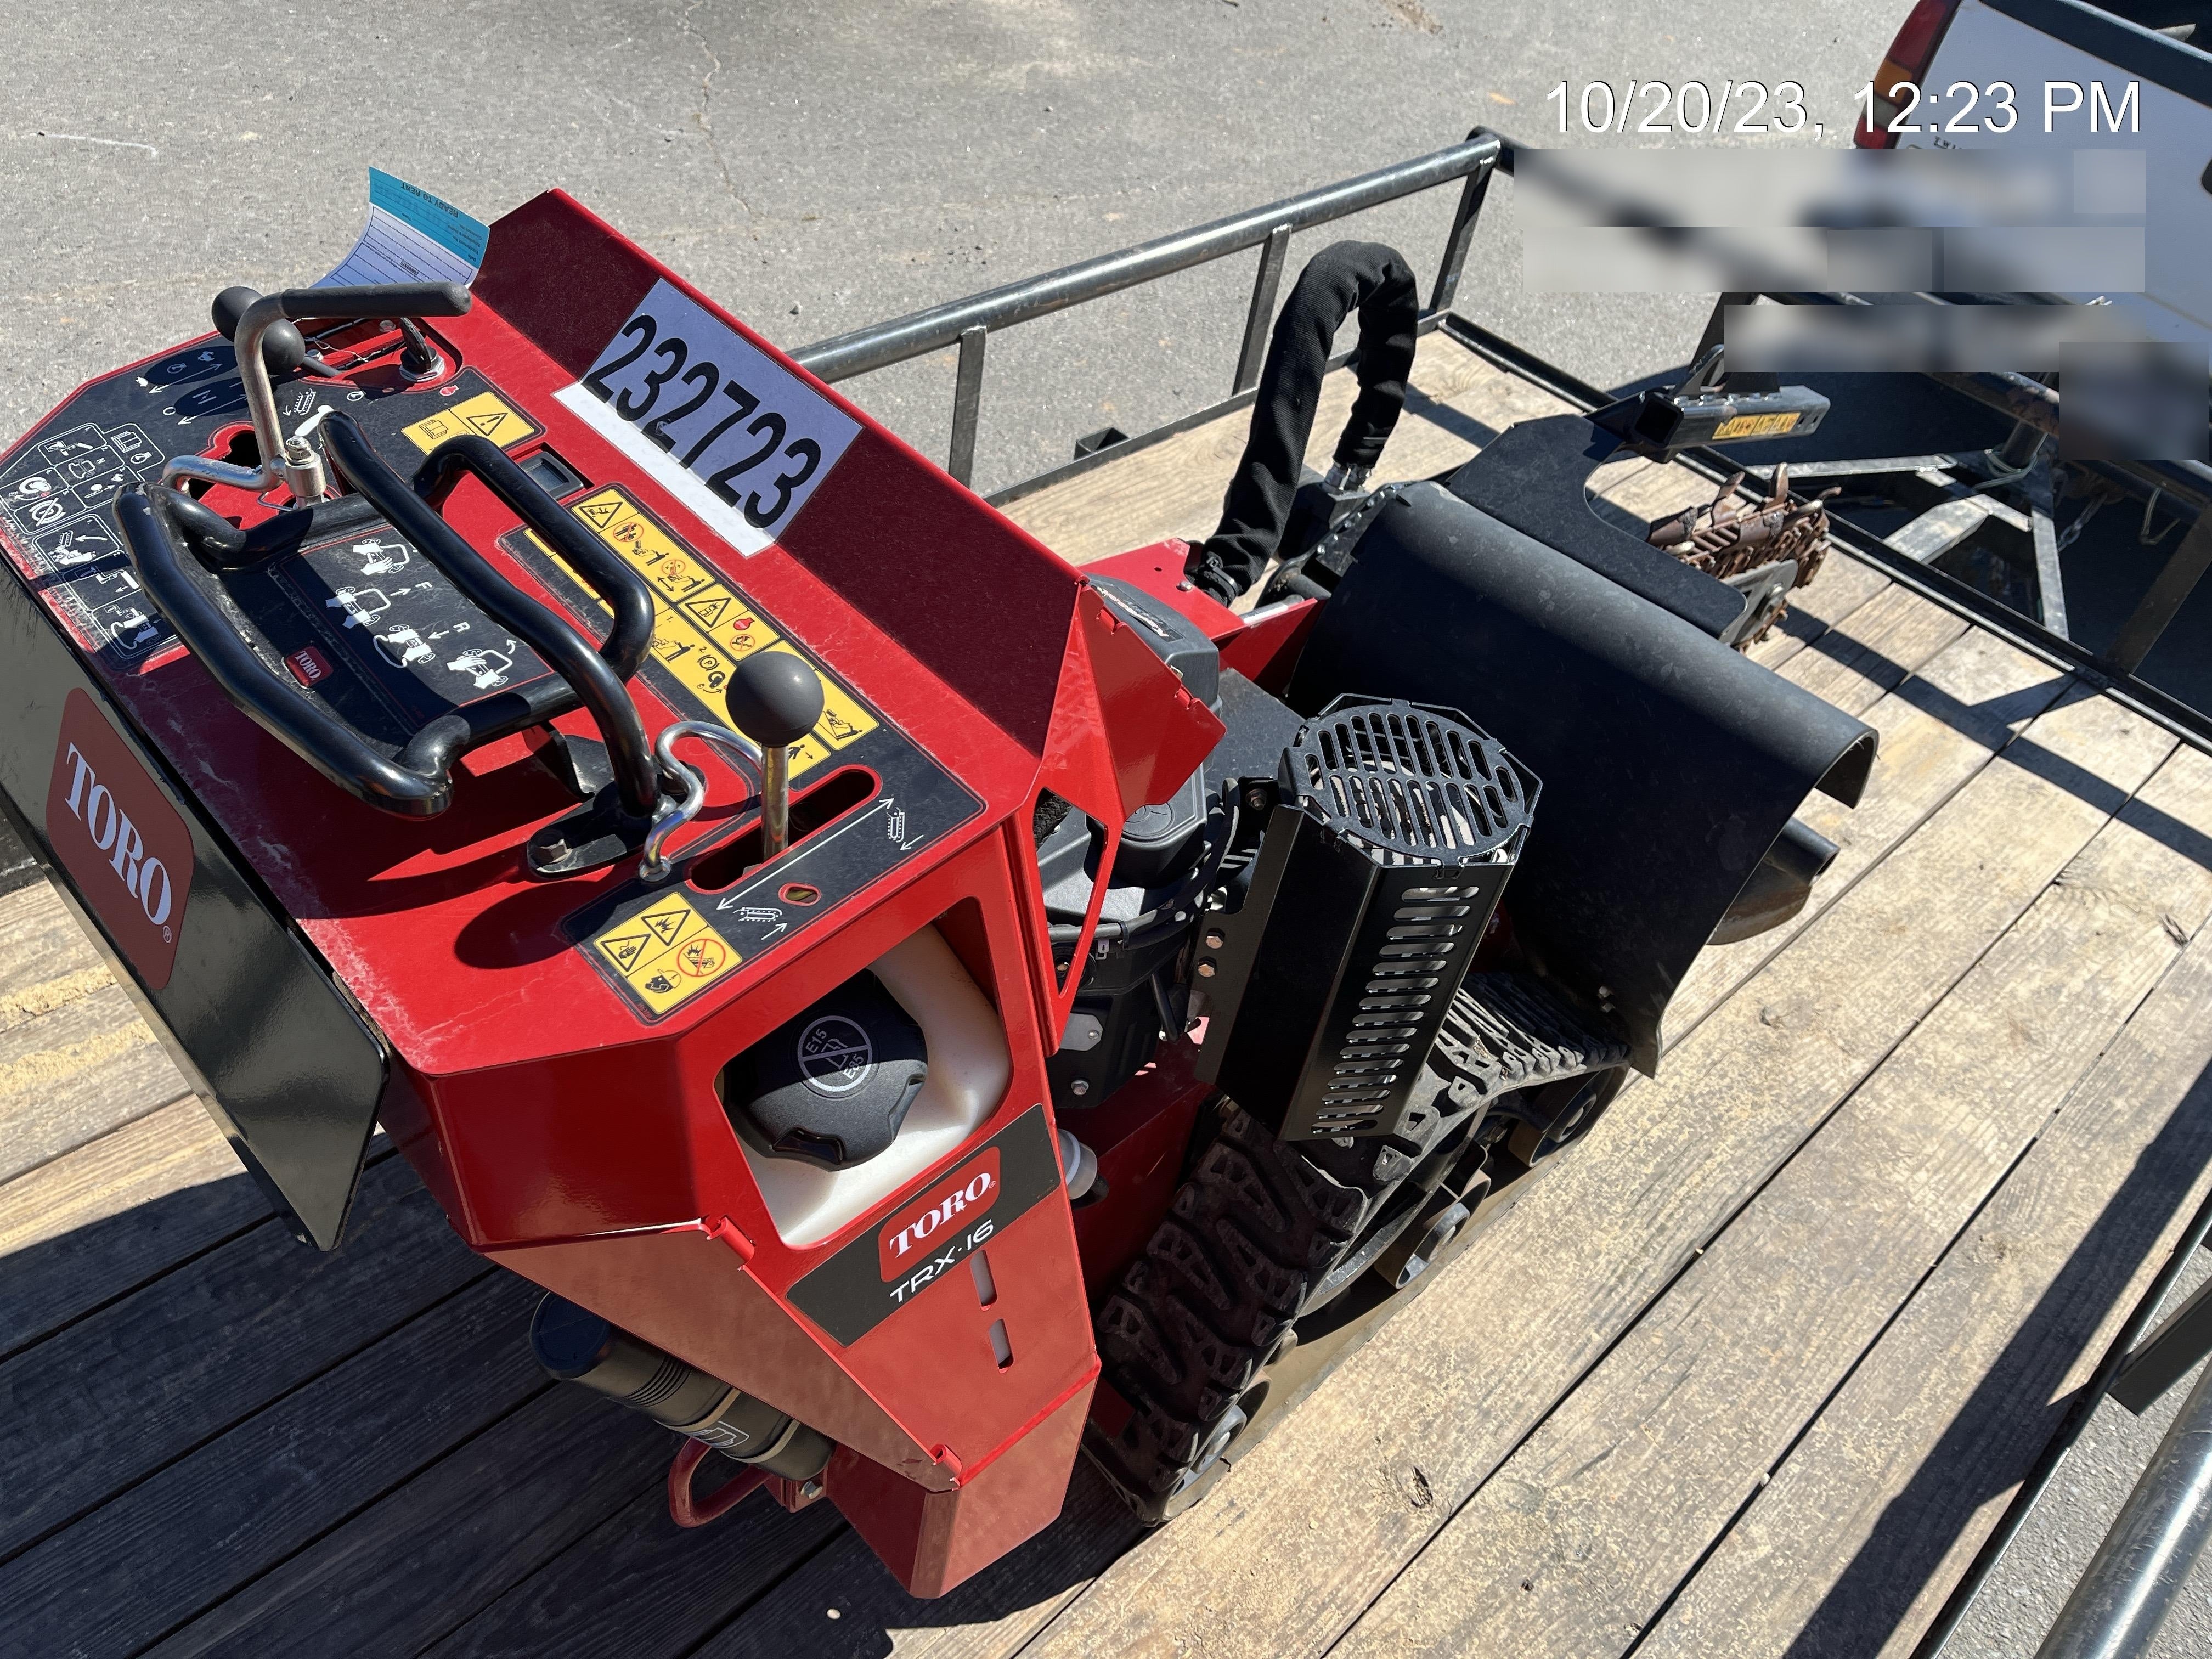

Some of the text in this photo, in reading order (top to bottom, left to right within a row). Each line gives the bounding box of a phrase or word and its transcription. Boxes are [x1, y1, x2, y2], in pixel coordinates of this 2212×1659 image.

[400, 183, 459, 218] READY TO RENT
[400, 260, 419, 275] COMMENTS
[468, 254, 477, 262] Date
[581, 314, 821, 529] 232723
[415, 580, 433, 591] F
[452, 621, 471, 633] R
[294, 650, 321, 681] TORO
[65, 742, 172, 925] TORO
[805, 1028, 827, 1054] E15
[843, 1053, 865, 1081] E85
[889, 1171, 991, 1259] TORO
